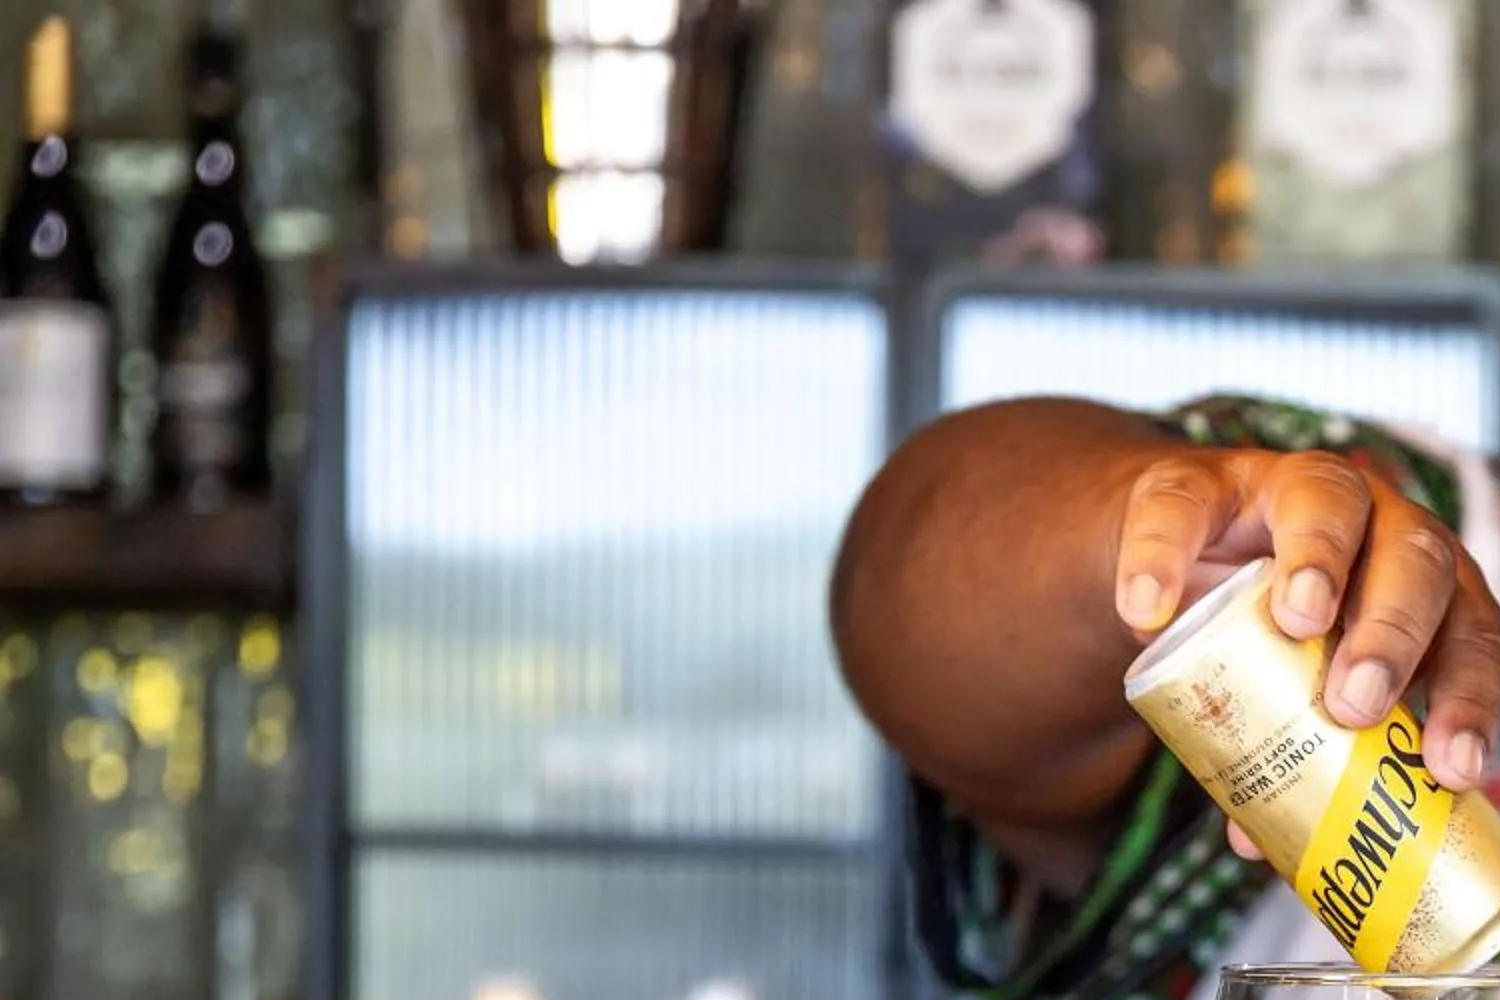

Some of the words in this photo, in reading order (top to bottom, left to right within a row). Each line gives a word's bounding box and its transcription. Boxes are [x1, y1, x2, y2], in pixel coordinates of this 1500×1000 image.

[1264, 737, 1295, 766] SOFT
[1272, 732, 1326, 779] TONIC
[1231, 763, 1263, 789] DRINK
[1312, 720, 1440, 949] Schwepp
